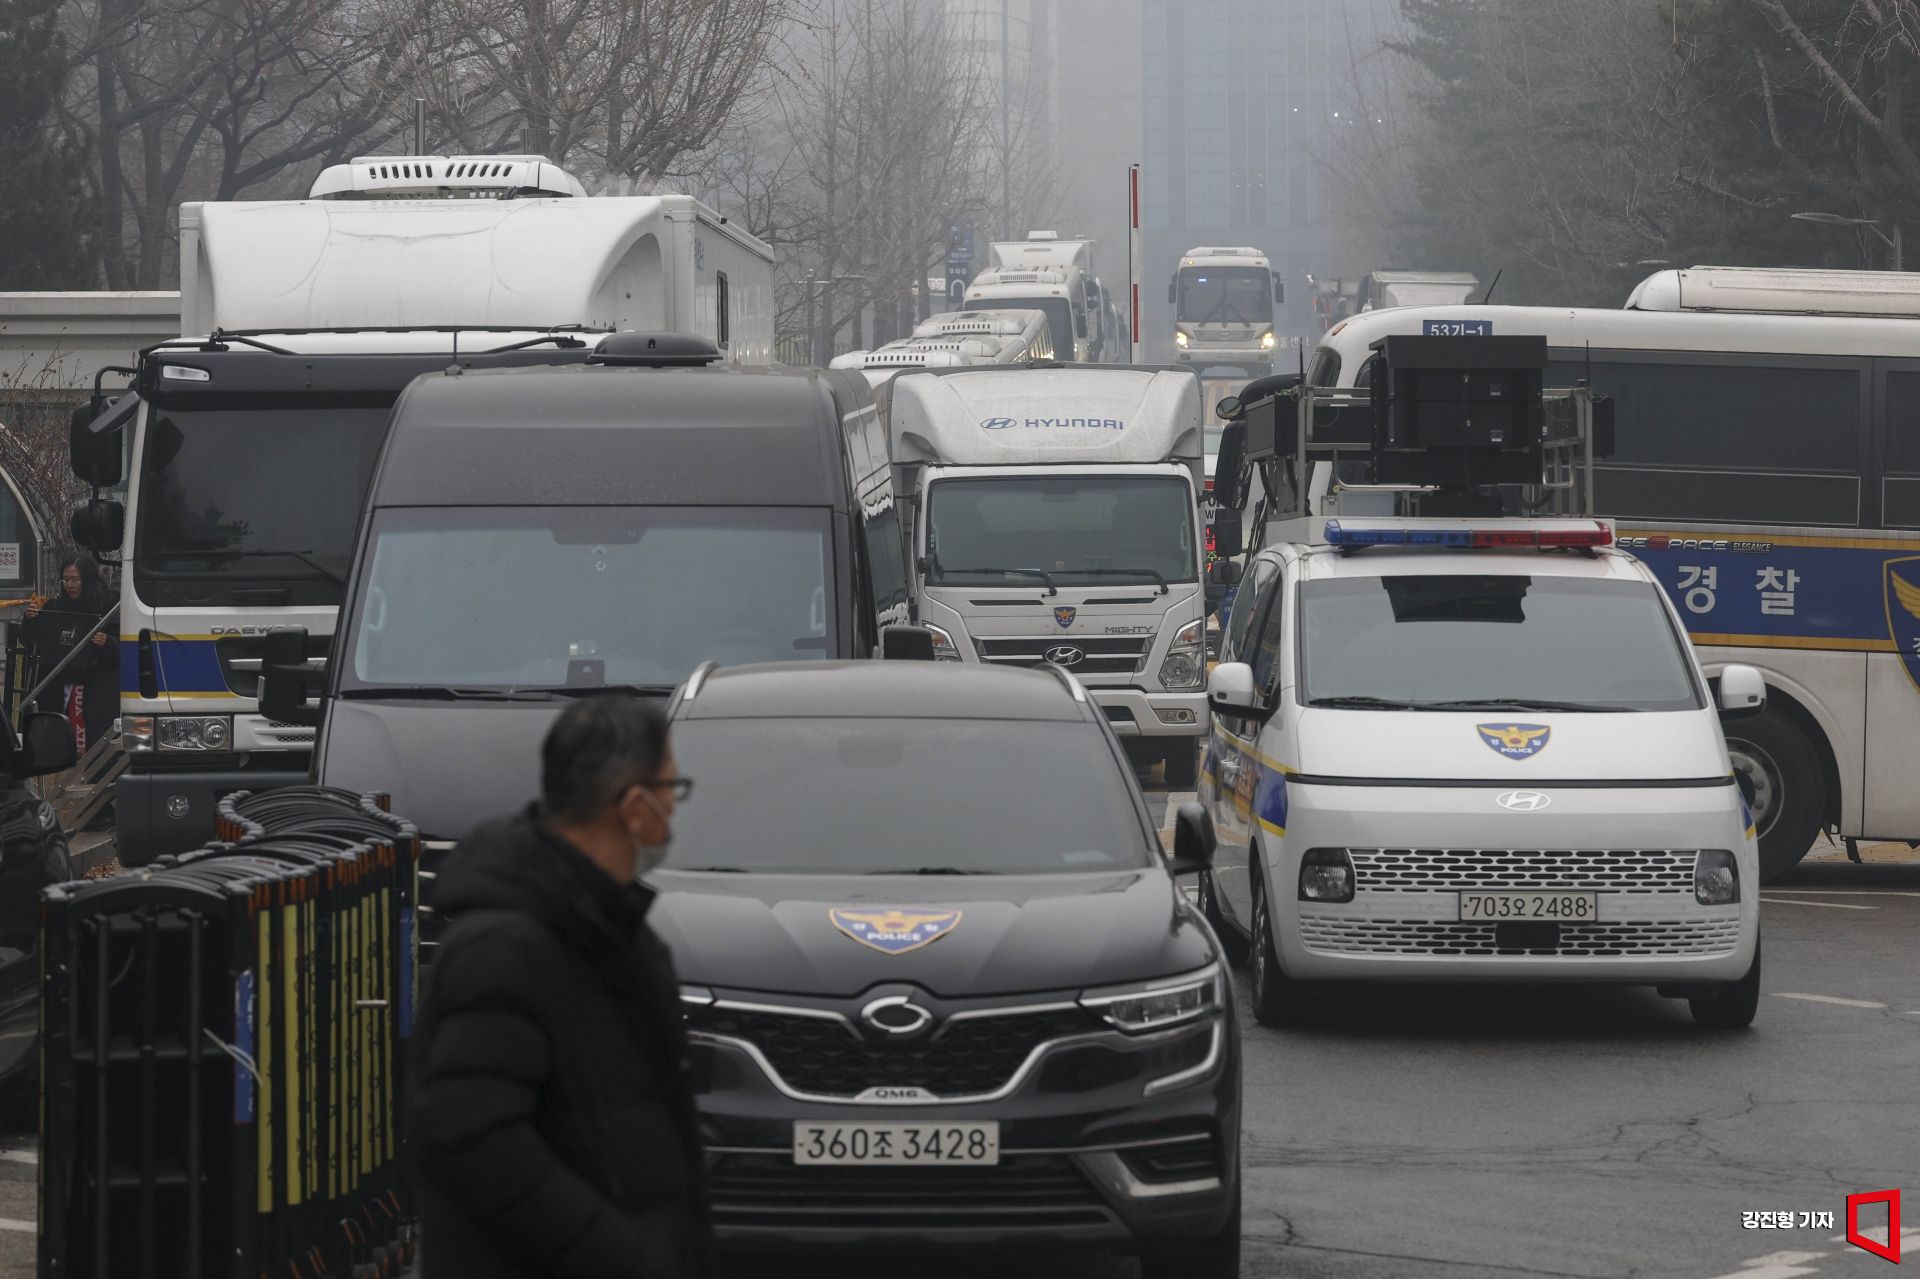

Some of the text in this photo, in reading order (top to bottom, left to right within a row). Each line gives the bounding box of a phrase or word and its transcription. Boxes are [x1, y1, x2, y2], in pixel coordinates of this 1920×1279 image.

[1025, 418, 1124, 430] HYUNDAI
[1733, 542, 1771, 552] ELEGANCE
[211, 625, 302, 635] DAEW
[867, 932, 921, 941] POLICE
